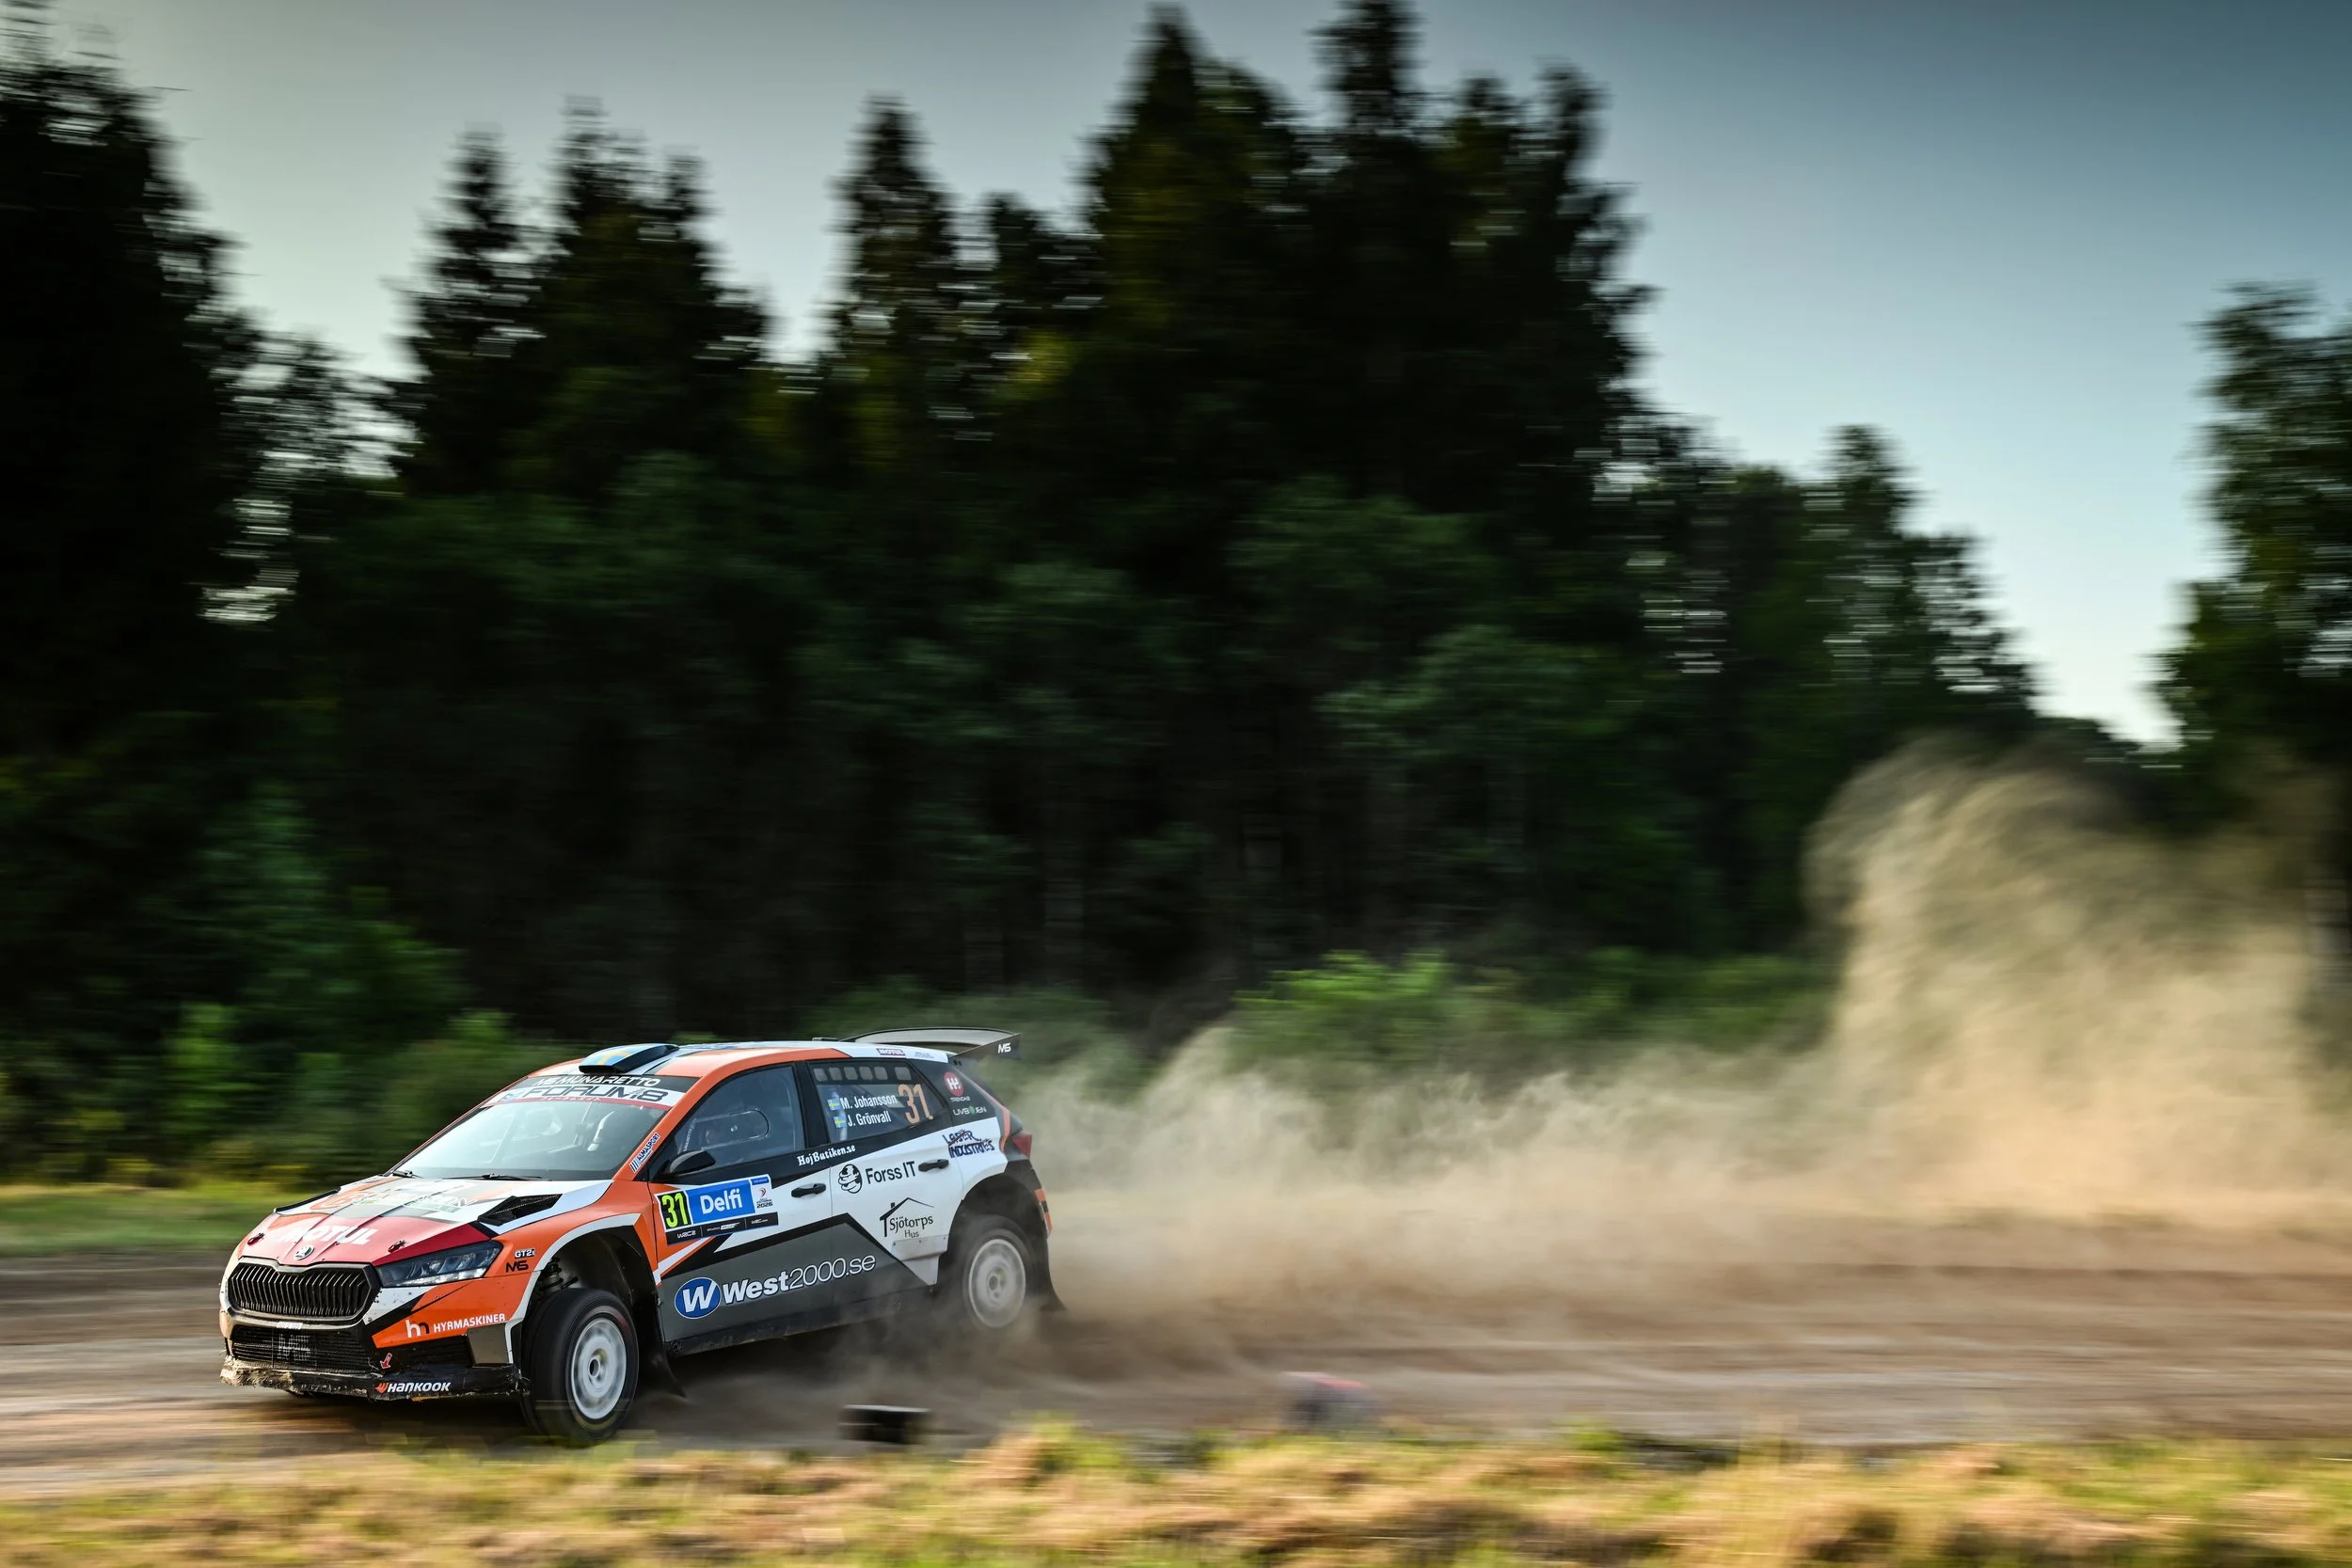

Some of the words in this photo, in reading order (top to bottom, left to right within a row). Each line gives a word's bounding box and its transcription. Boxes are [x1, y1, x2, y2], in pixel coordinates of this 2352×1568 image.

[558, 1075, 660, 1087] MUNARETTO
[522, 1085, 669, 1102] FORUM8
[840, 1098, 852, 1110] M.
[854, 1095, 898, 1109] Johansson
[898, 1084, 933, 1124] 31
[847, 1114, 855, 1127] J.
[856, 1110, 892, 1126] Grönvall
[797, 1144, 856, 1166] HojButiken.se
[948, 1138, 994, 1158] INDUSTRIES
[866, 1167, 902, 1184] Forss
[902, 1161, 916, 1178] IT
[661, 1192, 689, 1228] 31
[700, 1188, 743, 1214] Delfi
[889, 1214, 933, 1233] Sjötorps
[904, 1229, 919, 1238] Hus
[722, 1255, 877, 1305] West2000.se
[434, 1313, 506, 1333] HYRMASKINER
